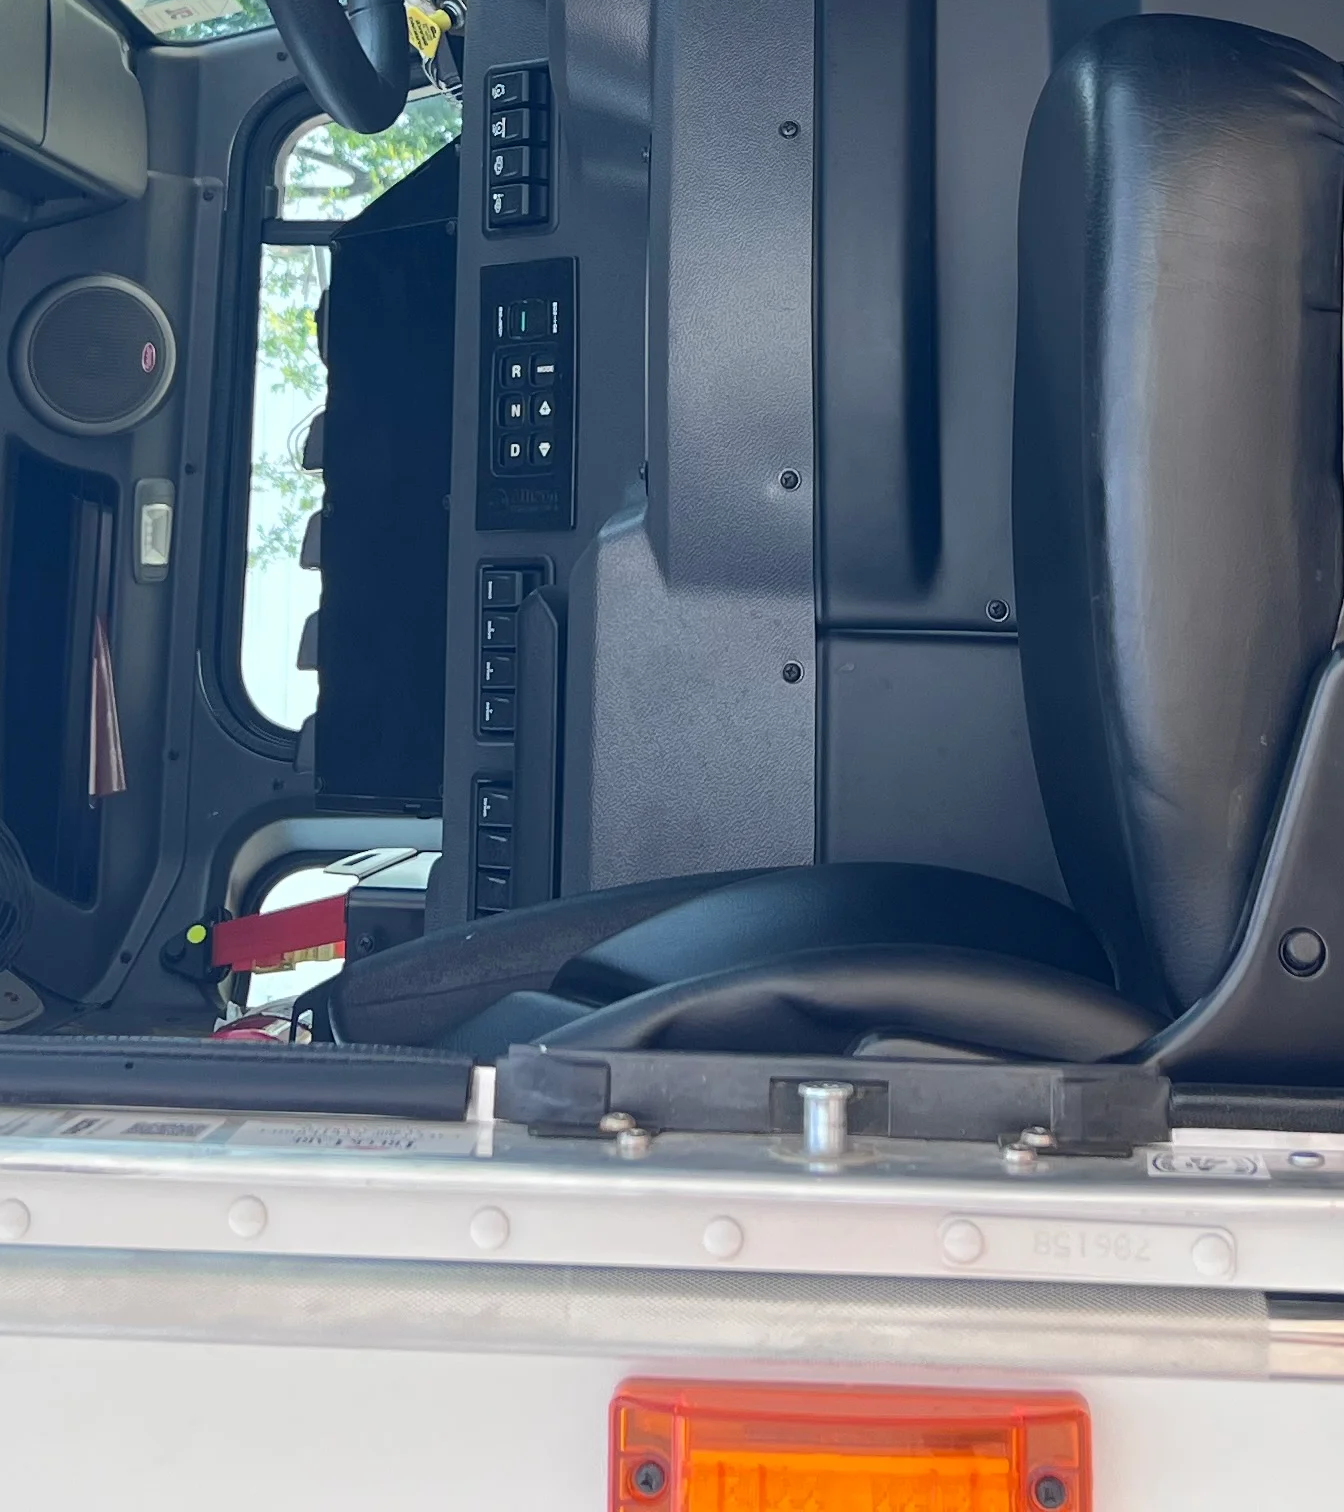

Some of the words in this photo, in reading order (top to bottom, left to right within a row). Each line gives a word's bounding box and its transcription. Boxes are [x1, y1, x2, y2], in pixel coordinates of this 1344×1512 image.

[511, 364, 522, 378] R
[511, 404, 521, 418] N
[510, 443, 521, 457] D
